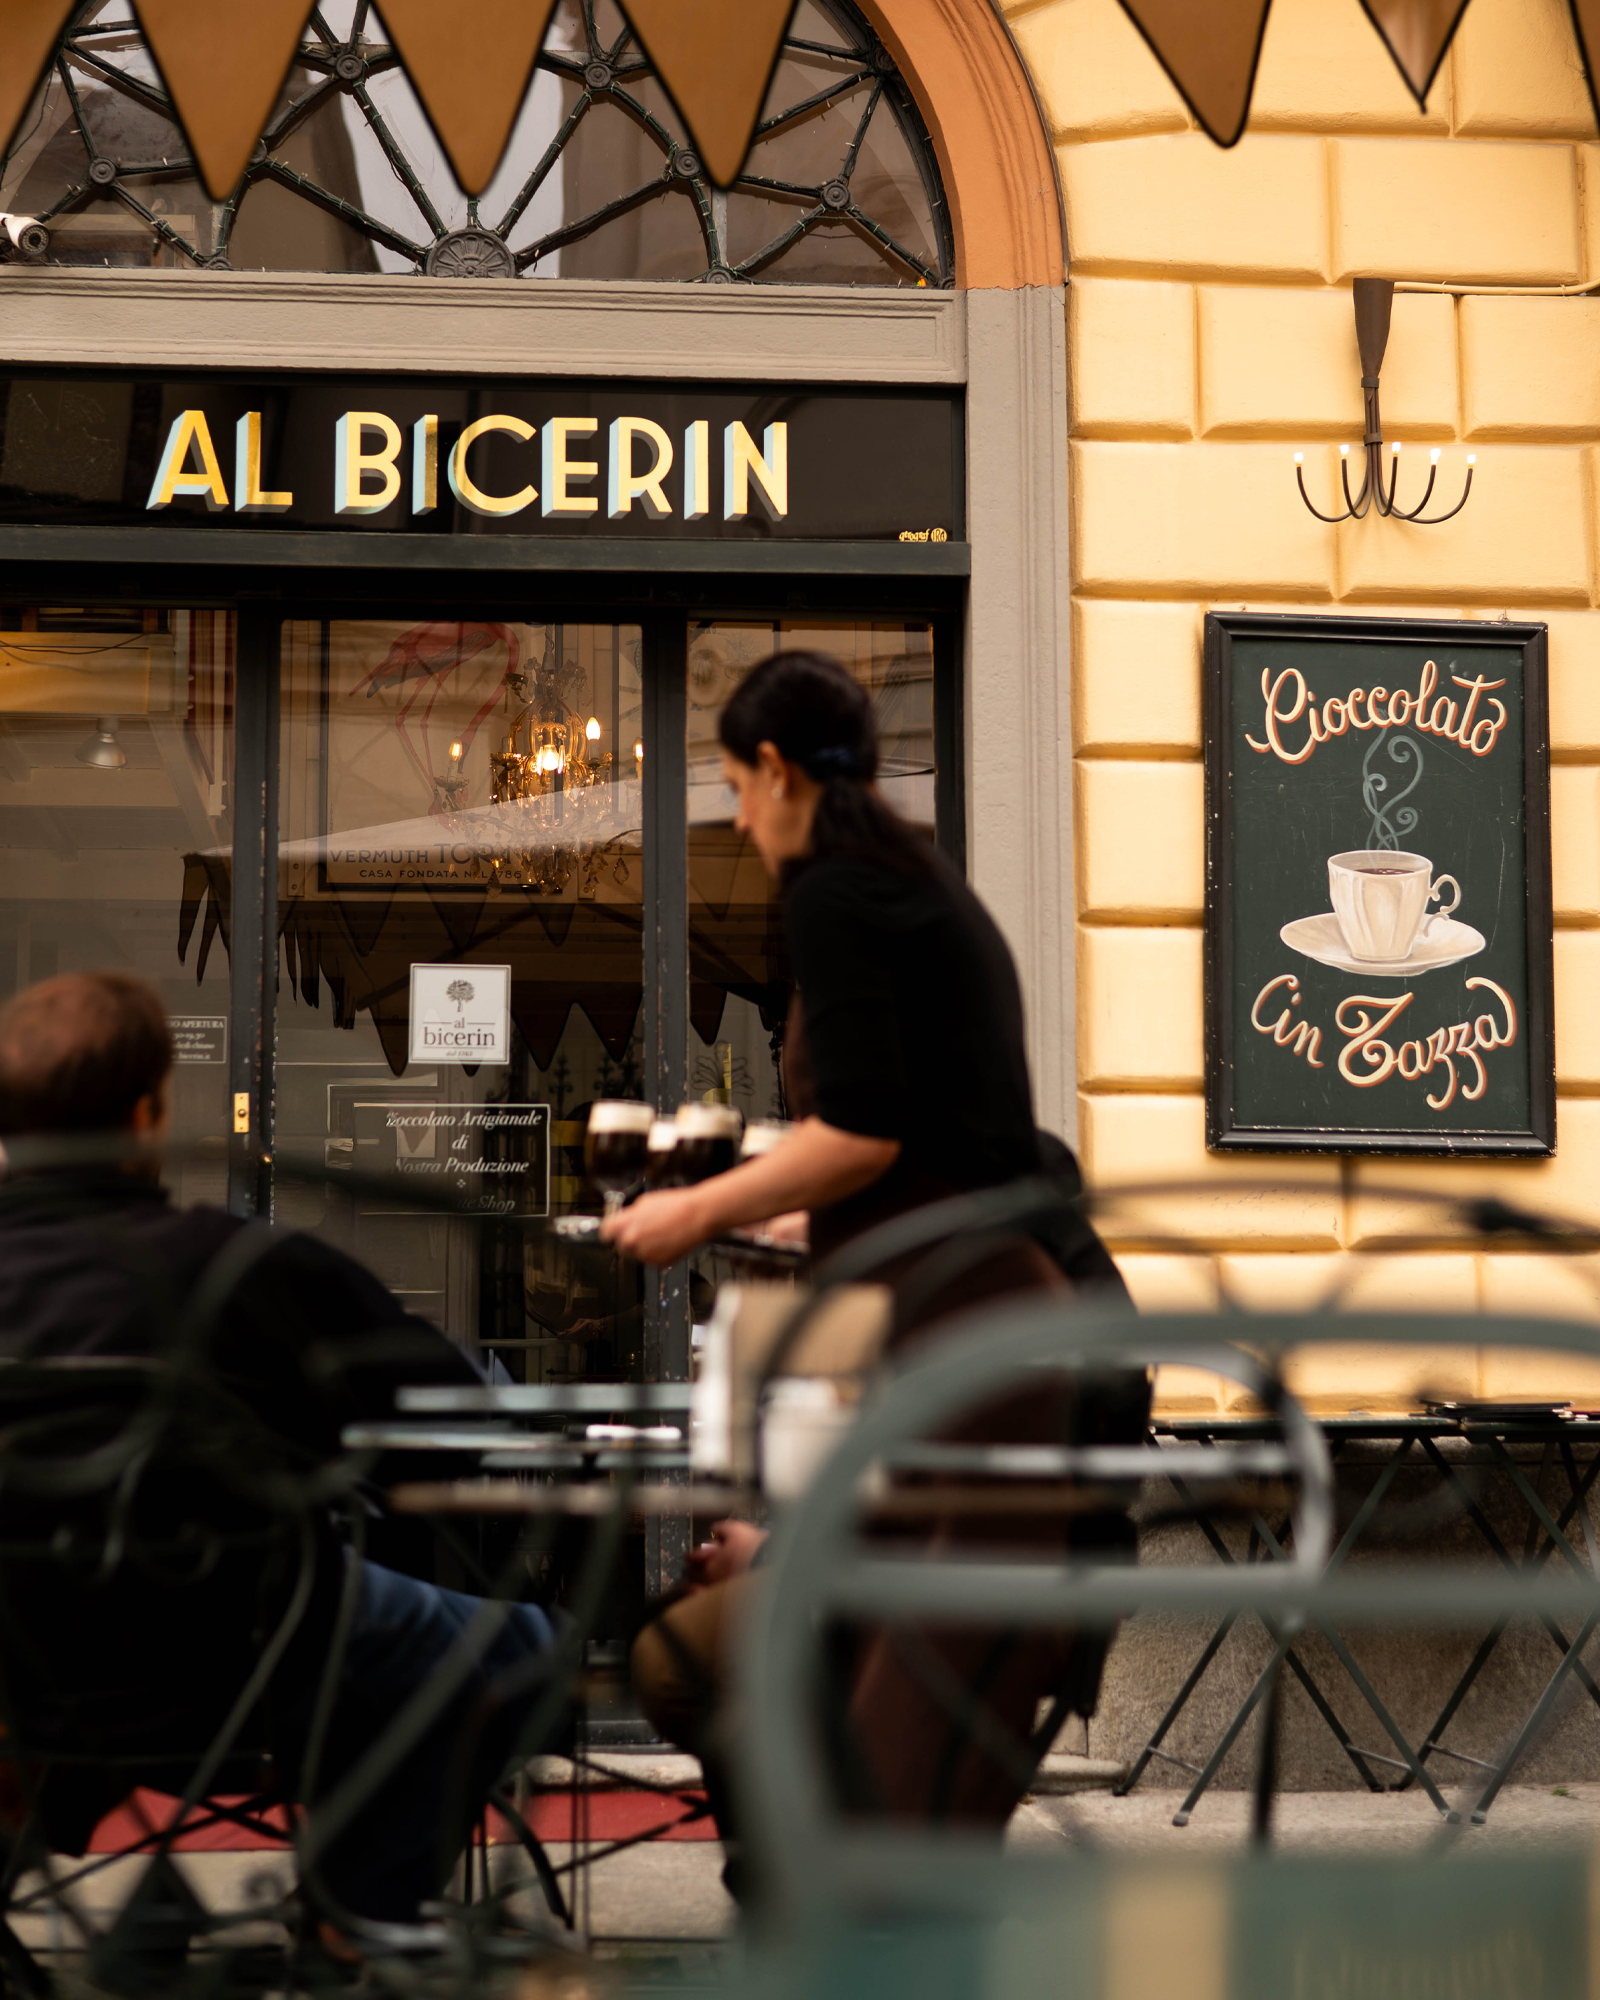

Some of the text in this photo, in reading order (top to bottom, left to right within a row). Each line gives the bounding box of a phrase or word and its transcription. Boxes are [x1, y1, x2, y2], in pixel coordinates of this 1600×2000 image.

[146, 409, 788, 520] AL BICERIN
[1245, 660, 1508, 764] Cioccolato
[329, 849, 429, 864] VERMUTH
[359, 869, 393, 879] CASA
[400, 869, 459, 879] FONDATA
[493, 870, 523, 879] 786
[453, 1017, 466, 1029] al
[423, 1026, 496, 1047] bicerin
[1334, 975, 1518, 1112] Tazza
[458, 1110, 543, 1131] Artigianale
[451, 1133, 470, 1150] di
[443, 1156, 530, 1173] Produzione
[477, 1194, 516, 1214] Shop
